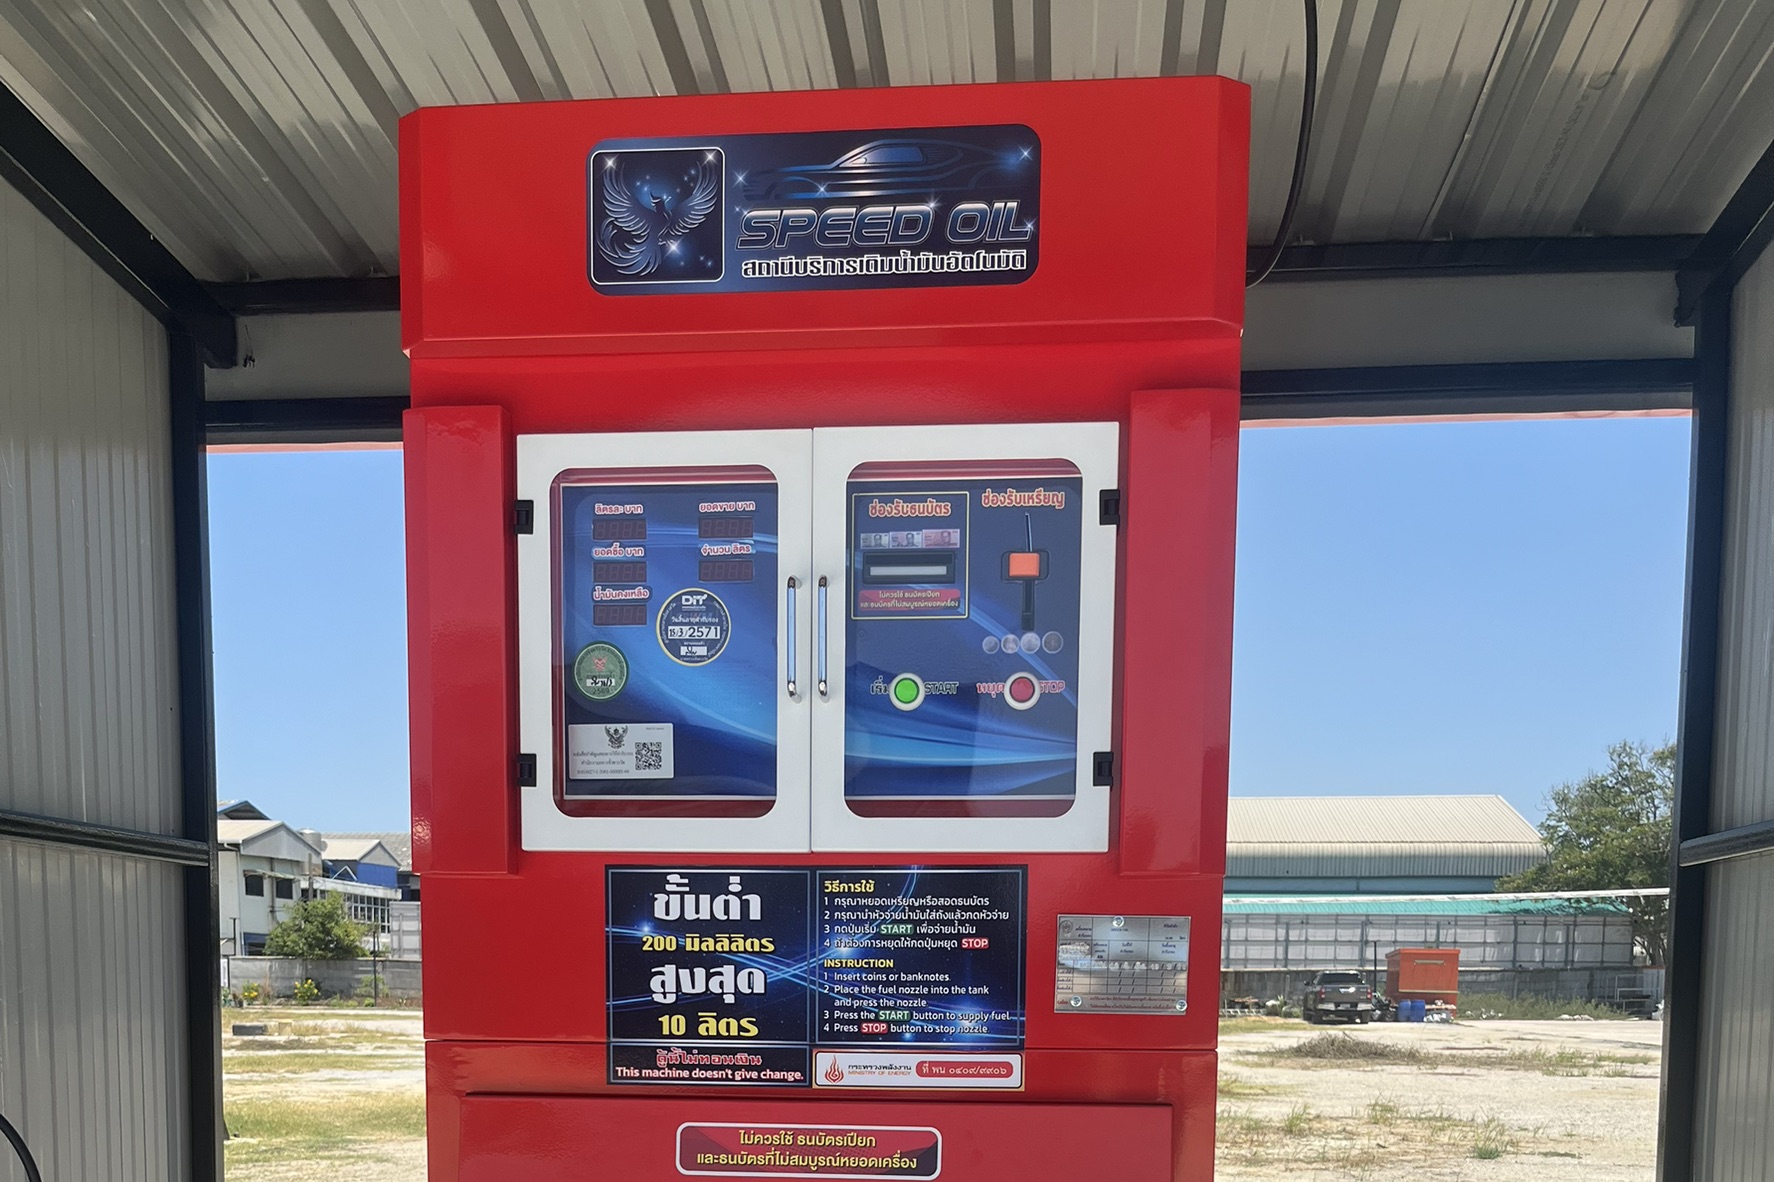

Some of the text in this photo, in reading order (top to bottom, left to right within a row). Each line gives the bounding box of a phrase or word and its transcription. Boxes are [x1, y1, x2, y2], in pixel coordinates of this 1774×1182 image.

[736, 200, 1032, 249] SPEED OIL
[741, 250, 1027, 278] สถานีบริการเติมน้ำมันอัตโนมัติ
[982, 488, 1065, 509] ช่องรับเหรียญ
[595, 504, 643, 514] ลิตรละ บาท
[699, 501, 755, 513] ยอดขาย บาท
[869, 498, 951, 517] ช่องรับธนบัตร
[593, 543, 644, 556] ยอดซื้อ บาท
[701, 544, 751, 556] จำนวน ลิตร
[593, 586, 649, 600] น้ำมันคงเหลือ
[924, 682, 959, 694] START
[1039, 681, 1065, 693] STOP
[824, 880, 875, 893] วิธีการใช้
[654, 874, 762, 921] ขั้นต่ำ
[824, 895, 990, 908] 1 กรุณาหยอดเหรียญหรือสอดธนบัตร
[824, 906, 1009, 922] 2 กรุณานำหัวจ่ายน้ำมันใส่ถังแล้วกดหัวจ่าย
[824, 921, 976, 936] 3 กดปุ่มเริ่ม START เพื่อจ่ายน้ำมัน
[642, 934, 775, 952] 200 มิลลิลิตร
[824, 937, 988, 950] 4 ถ้าต้องการหยุดให้กดปุ่มหยุด STOP
[824, 959, 894, 968] INSTRUCTION
[834, 972, 860, 981] Insert
[862, 973, 887, 981] coins
[650, 964, 765, 1004] สูงสุด
[824, 985, 989, 994] 2 Place the fuel nozzle into the tank
[834, 998, 851, 1006] and
[853, 1000, 878, 1009] press
[879, 998, 895, 1006] the
[823, 1010, 829, 1019] 3
[834, 1010, 858, 1019] Press
[860, 1010, 875, 1019] the
[879, 1011, 909, 1019] START
[913, 1011, 944, 1020] button
[946, 1012, 956, 1020] to
[958, 1011, 989, 1022] supply
[658, 1012, 759, 1037] 10 ลิตร
[823, 1023, 829, 1031] 4
[834, 1023, 858, 1031] Press
[862, 1023, 887, 1032] STOP
[890, 1024, 922, 1032] button
[935, 1025, 956, 1035] stop
[615, 1067, 804, 1082] This machine doesn't give change.
[932, 1066, 945, 1074] พน
[739, 1130, 875, 1147] ไม่ควรใช้ ธนบัตรเปียก
[697, 1148, 917, 1171] และธนบัตรที่ไม่สมบูรณ์หยอดเครื่อง
